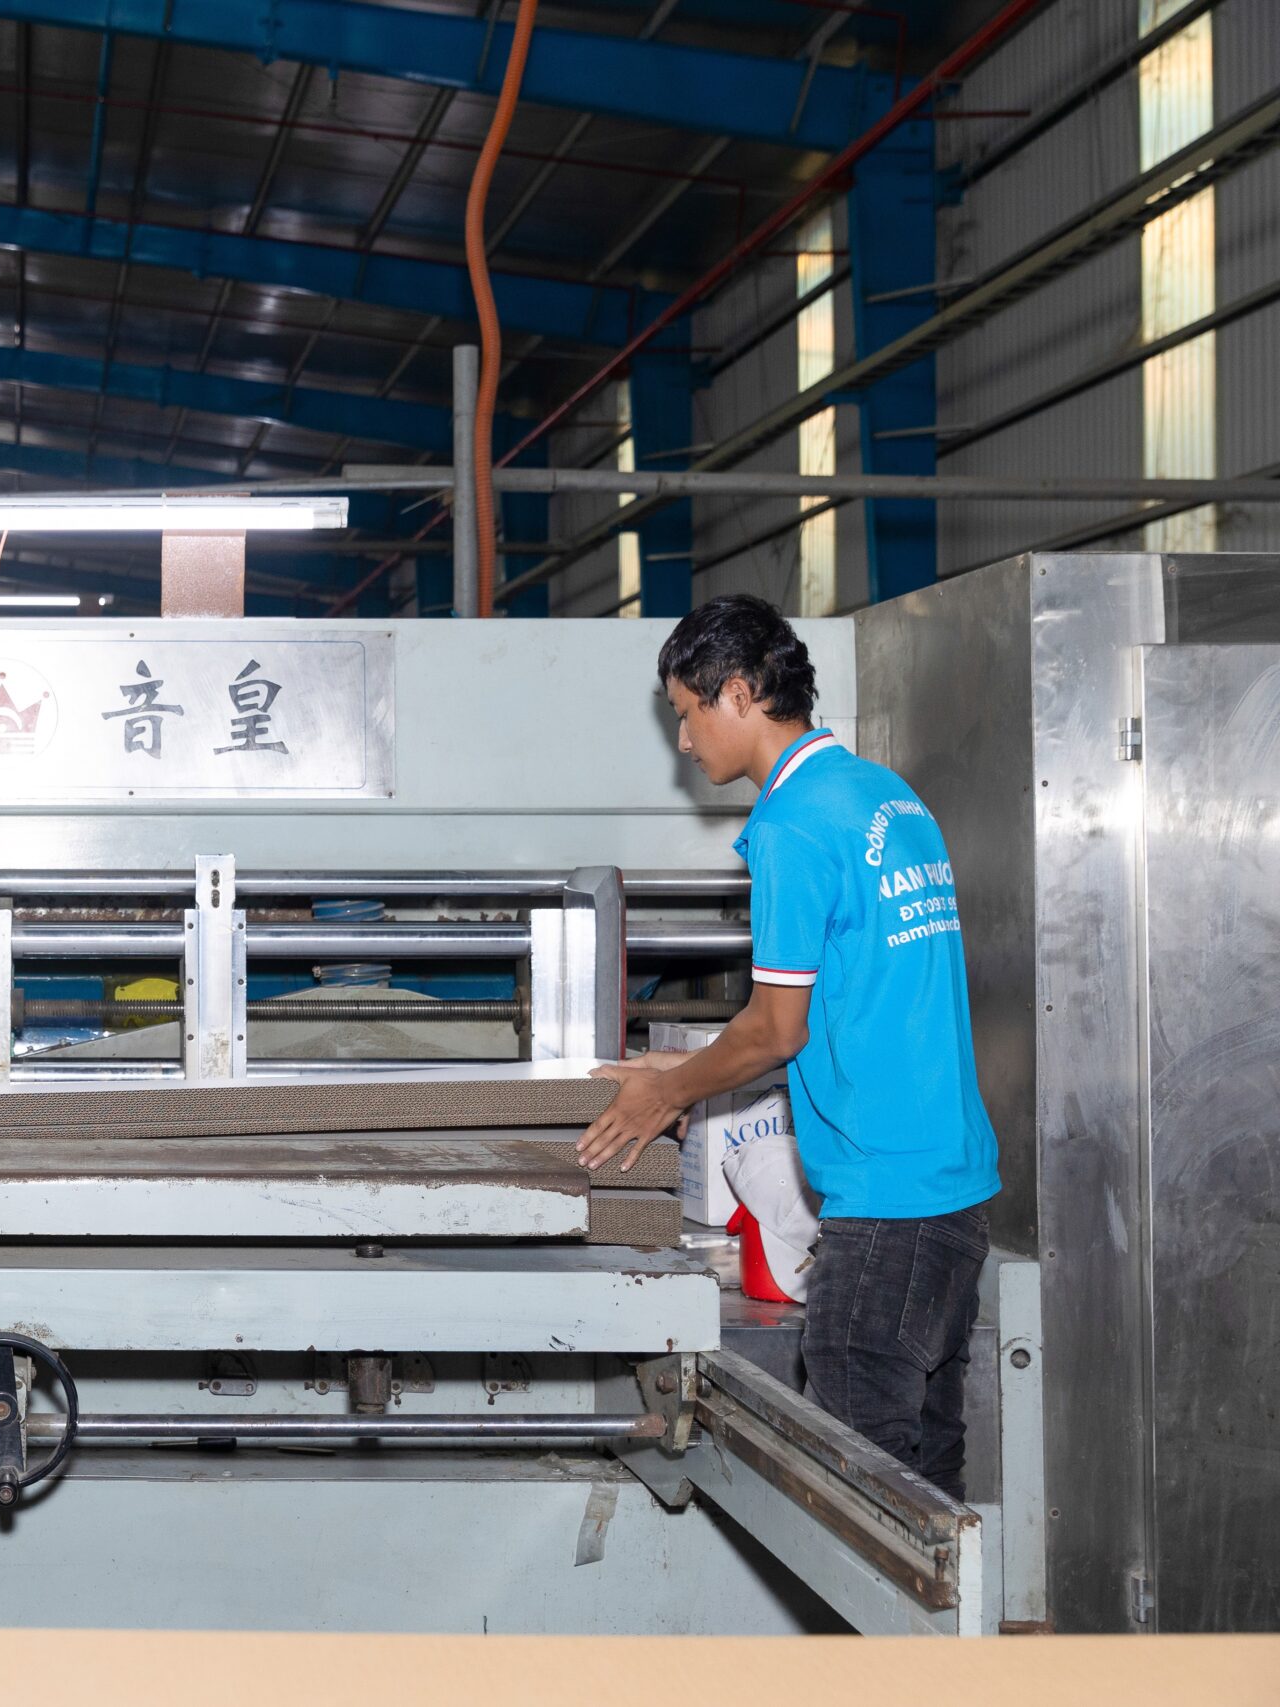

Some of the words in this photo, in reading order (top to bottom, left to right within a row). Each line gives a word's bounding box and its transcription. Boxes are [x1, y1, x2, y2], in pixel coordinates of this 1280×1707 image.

[101, 659, 289, 759] 音皇
[890, 800, 925, 816] TNHH
[879, 864, 926, 902] NAM
